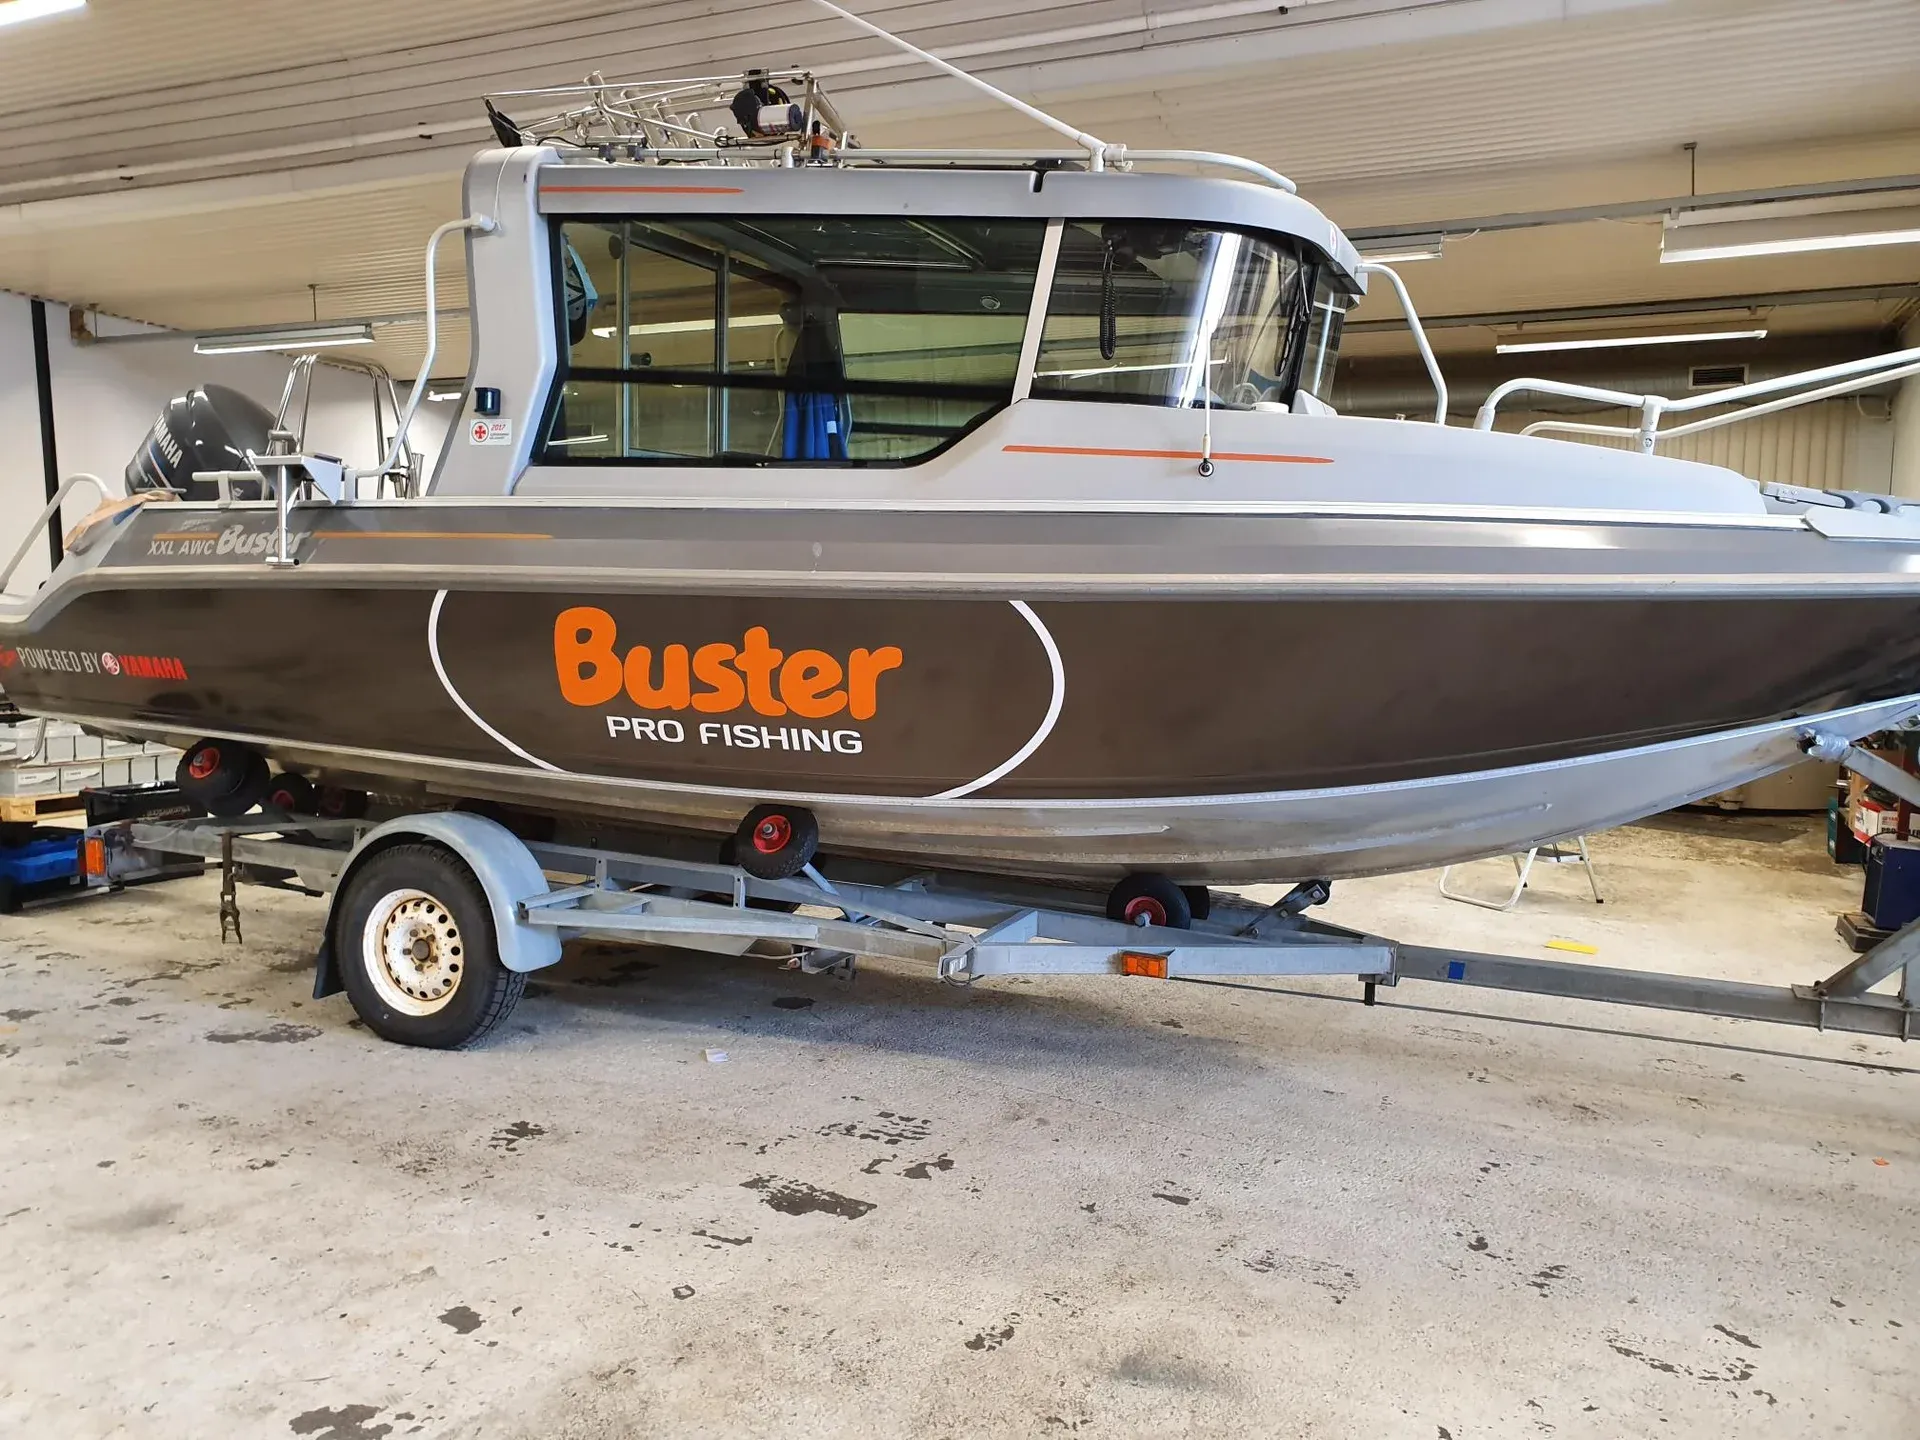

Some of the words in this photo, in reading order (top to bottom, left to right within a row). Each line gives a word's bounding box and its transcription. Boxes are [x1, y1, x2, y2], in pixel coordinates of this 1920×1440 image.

[148, 541, 174, 555] XXL
[179, 540, 215, 555] AWC
[16, 646, 82, 673] POWERED
[82, 652, 101, 674] BY
[119, 654, 188, 680] YAMAHA
[554, 606, 903, 720] Buster
[606, 715, 685, 743] PRO
[699, 722, 863, 754] FISHING
